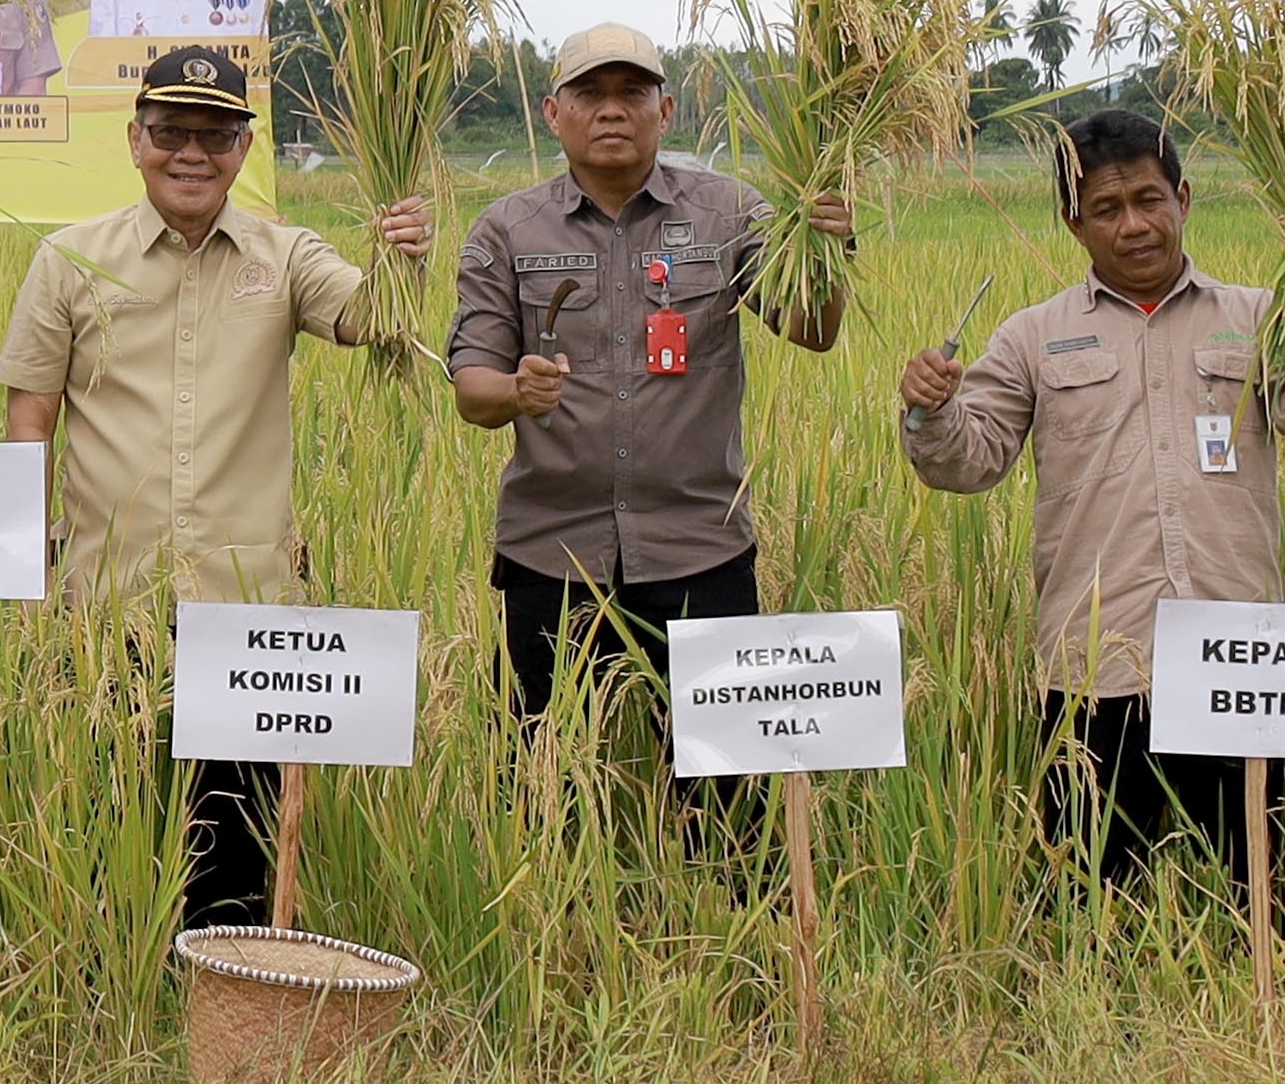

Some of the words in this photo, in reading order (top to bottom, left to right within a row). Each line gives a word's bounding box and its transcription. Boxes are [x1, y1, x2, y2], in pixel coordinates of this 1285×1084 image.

[147, 45, 157, 59] H
[16, 117, 47, 129] LAUT
[523, 256, 588, 269] FARIED
[247, 630, 347, 653] KETUA
[736, 646, 837, 667] KEPALA
[229, 670, 333, 693] KOMISI
[344, 675, 361, 695] II
[692, 680, 882, 705] DISTANHORBUN
[1211, 689, 1285, 715] BBT
[255, 713, 333, 734] DPRD
[758, 718, 821, 737] TALA
